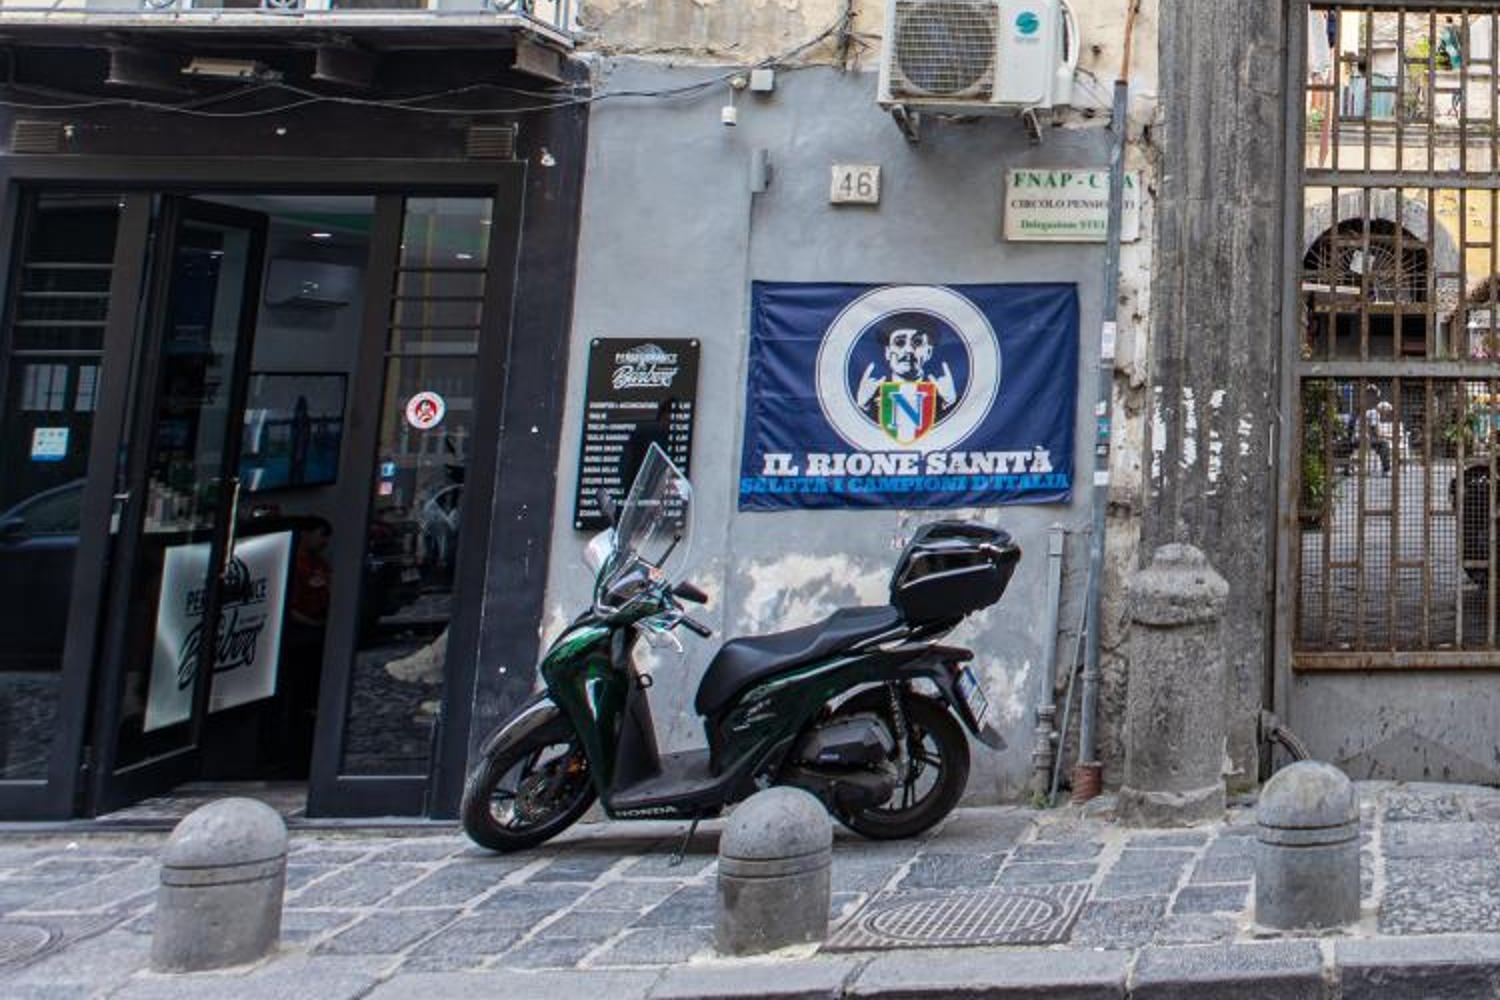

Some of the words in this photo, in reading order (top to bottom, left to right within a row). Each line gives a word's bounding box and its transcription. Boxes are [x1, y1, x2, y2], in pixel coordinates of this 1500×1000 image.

[839, 171, 873, 198] 46
[1013, 171, 1073, 188] FNAP
[1011, 199, 1066, 209] CIRCOLO
[890, 393, 924, 428] N
[762, 452, 799, 476] IL
[806, 451, 919, 476] RIONE
[925, 445, 1053, 475] SANITÀ
[740, 475, 829, 494] SALUTA
[847, 475, 968, 493] CAMPIONI
[975, 473, 1070, 491] D'ITALIA
[615, 805, 679, 818] HONDA
